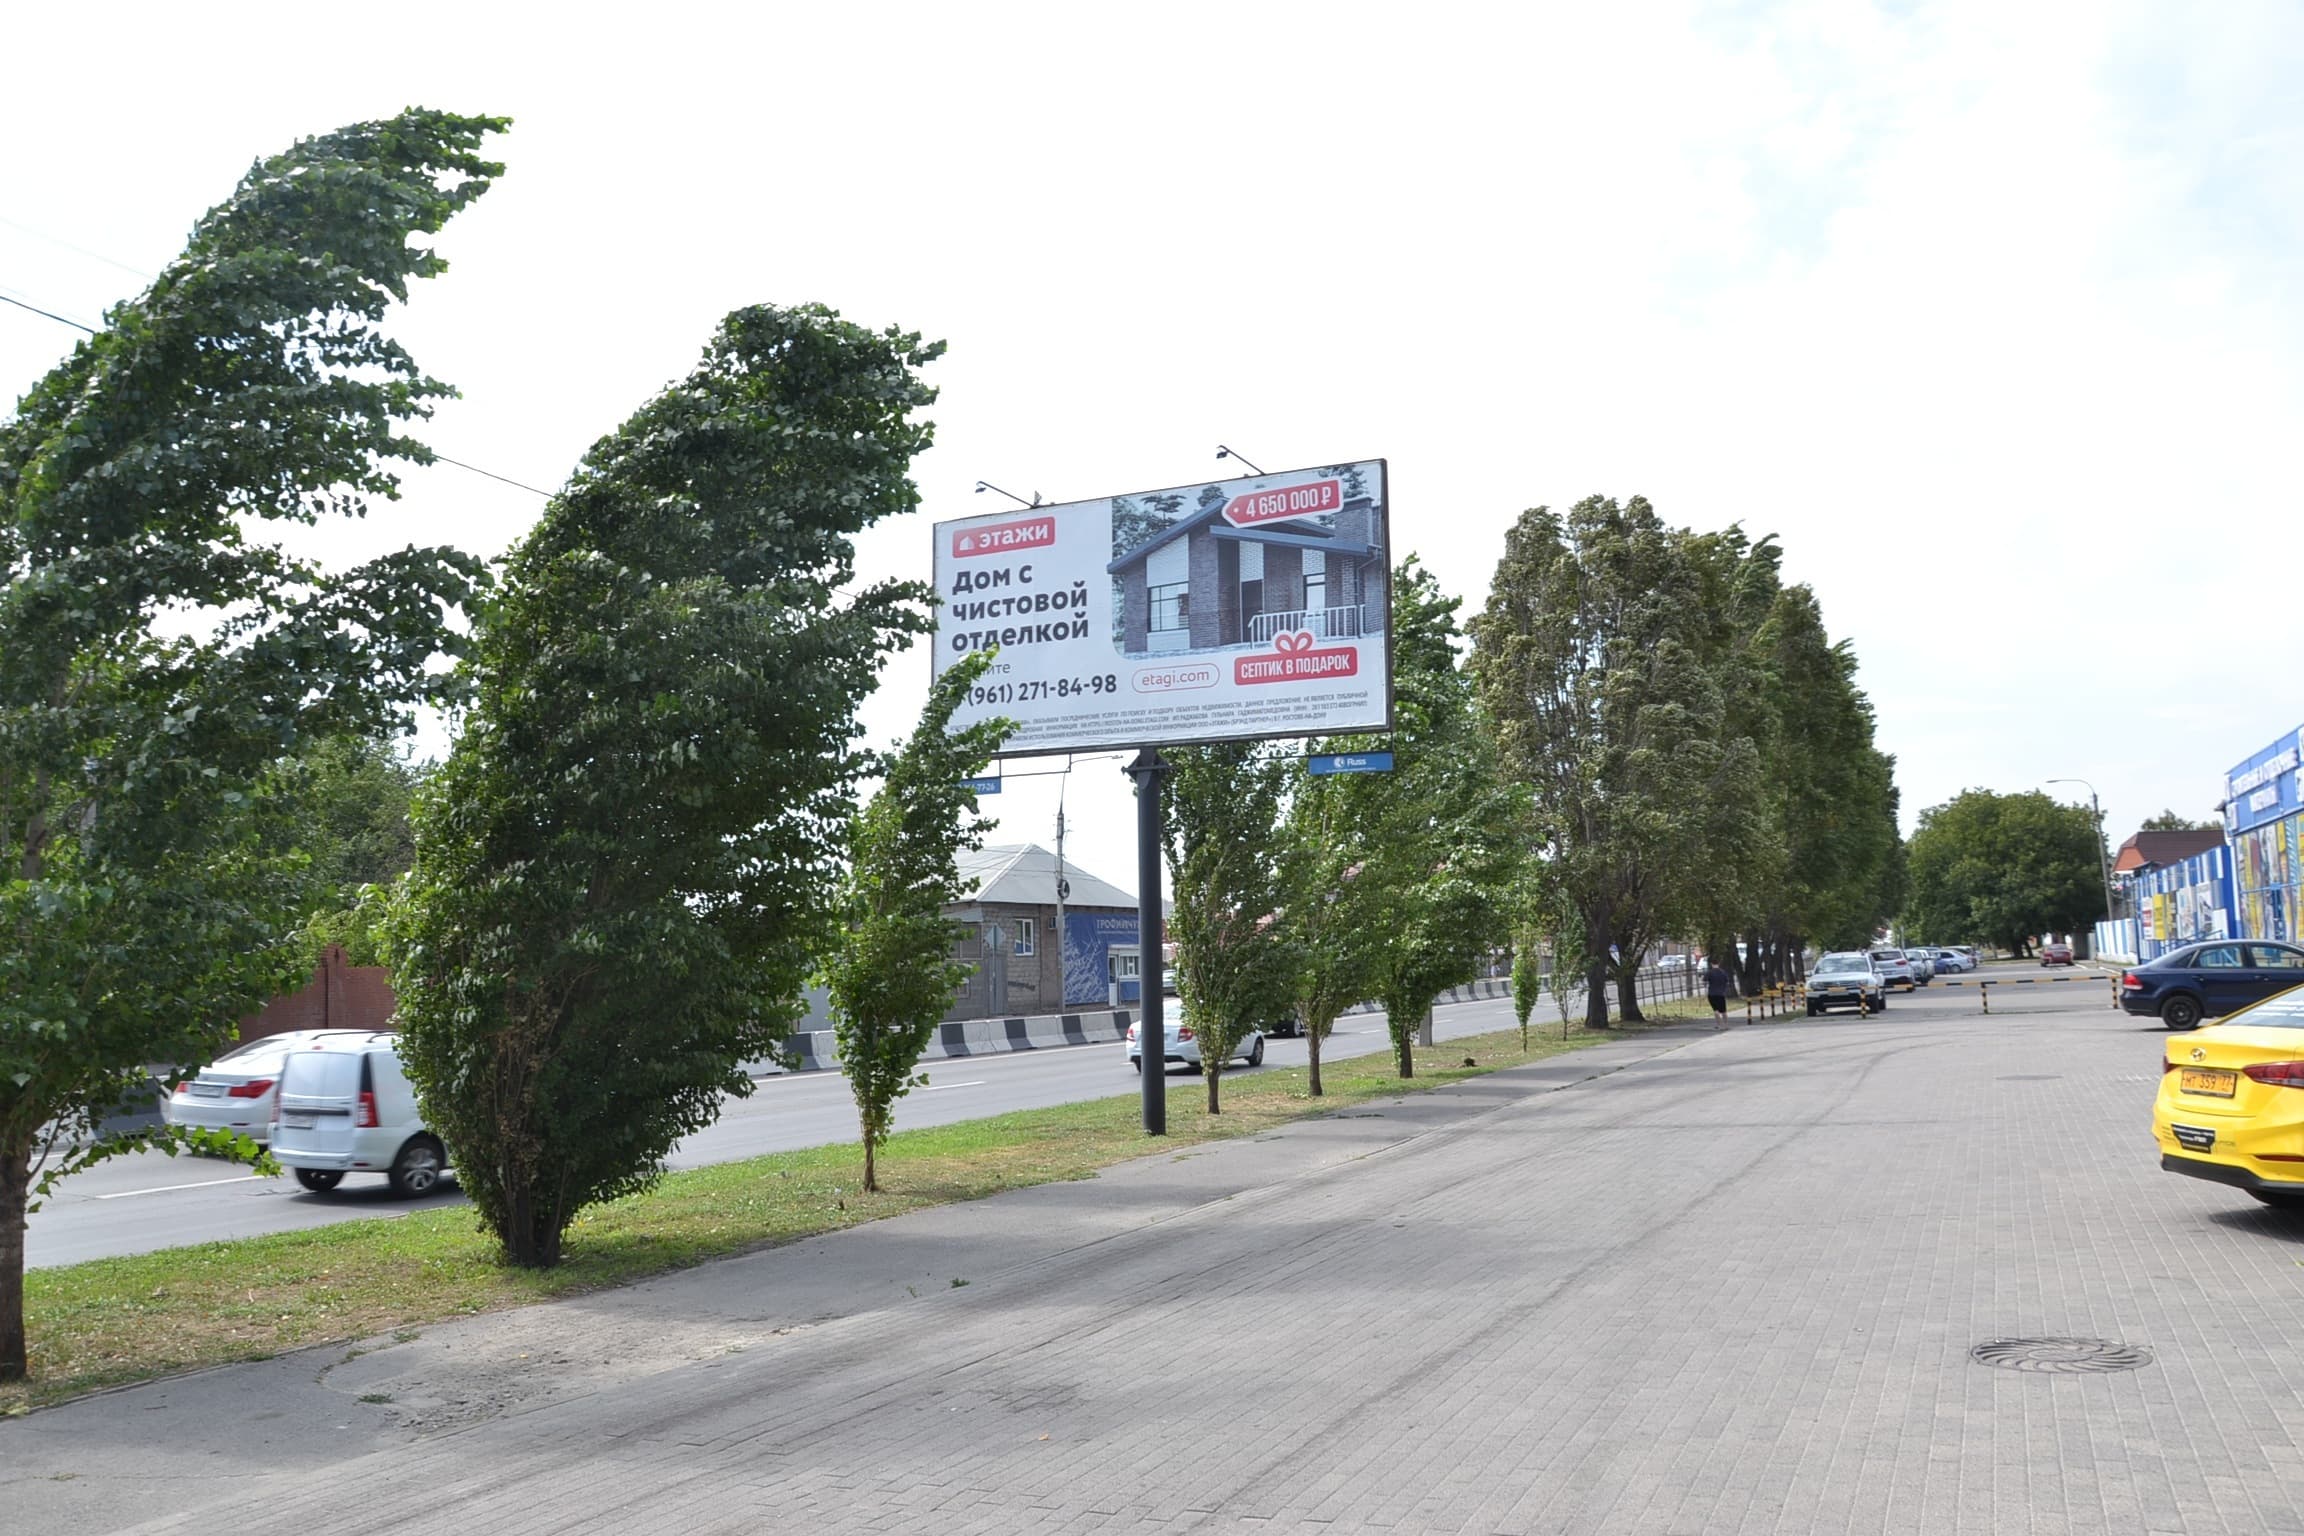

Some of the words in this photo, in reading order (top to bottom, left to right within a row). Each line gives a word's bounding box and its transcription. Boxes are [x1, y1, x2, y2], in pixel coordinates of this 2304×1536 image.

[1245, 498, 1256, 517] 4
[1259, 493, 1286, 516] 650
[1290, 488, 1319, 511] 000
[952, 567, 1011, 596] Дом
[1018, 564, 1033, 584] с
[952, 580, 1087, 622] чистовой
[951, 611, 1089, 652] отделкой
[1142, 669, 1210, 688] etagi.com
[1240, 658, 1283, 679] СЕПТИК
[1286, 657, 1294, 675] В
[1295, 653, 1350, 675] ПОДАРОК
[968, 683, 1013, 706] (961)
[1018, 674, 1117, 701] 271-84-98
